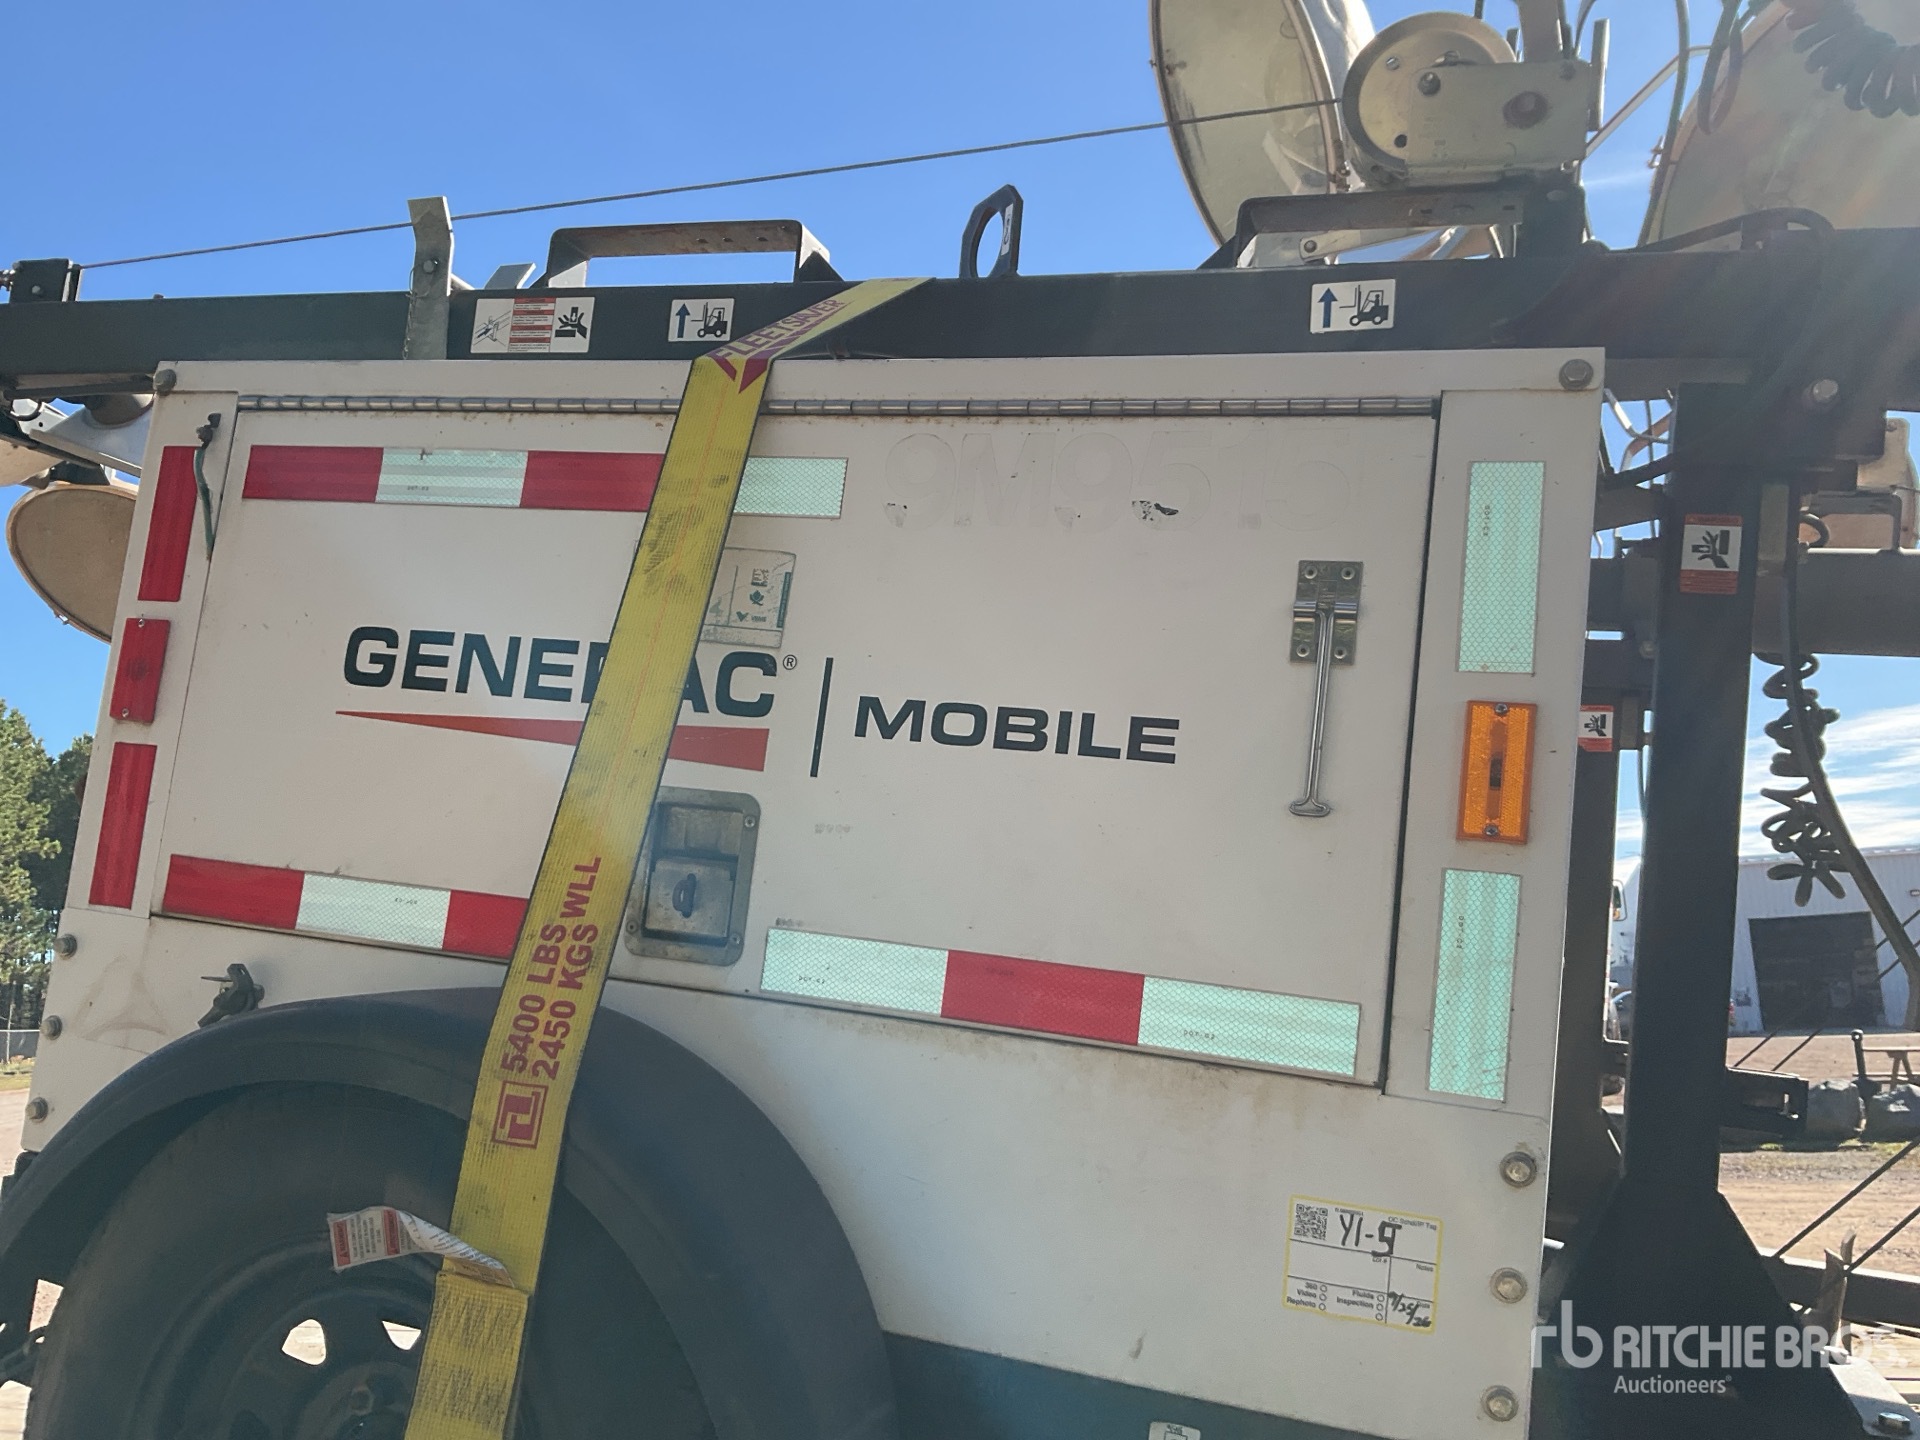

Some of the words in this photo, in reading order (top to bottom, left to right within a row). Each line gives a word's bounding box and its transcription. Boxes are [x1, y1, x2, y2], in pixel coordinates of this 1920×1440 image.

[697, 299, 844, 382] FLEETSAVER
[855, 696, 1179, 764] MOBILE
[502, 994, 546, 1073] 5400
[527, 924, 566, 985] LBS
[560, 856, 601, 918] WLL
[532, 1001, 576, 1080] 2450
[558, 924, 598, 990] KGS
[1286, 1296, 1316, 1308] Rephoto
[1297, 1288, 1317, 1298] Video
[1336, 1296, 1374, 1309] Inspection
[1352, 1290, 1374, 1300] Fluids
